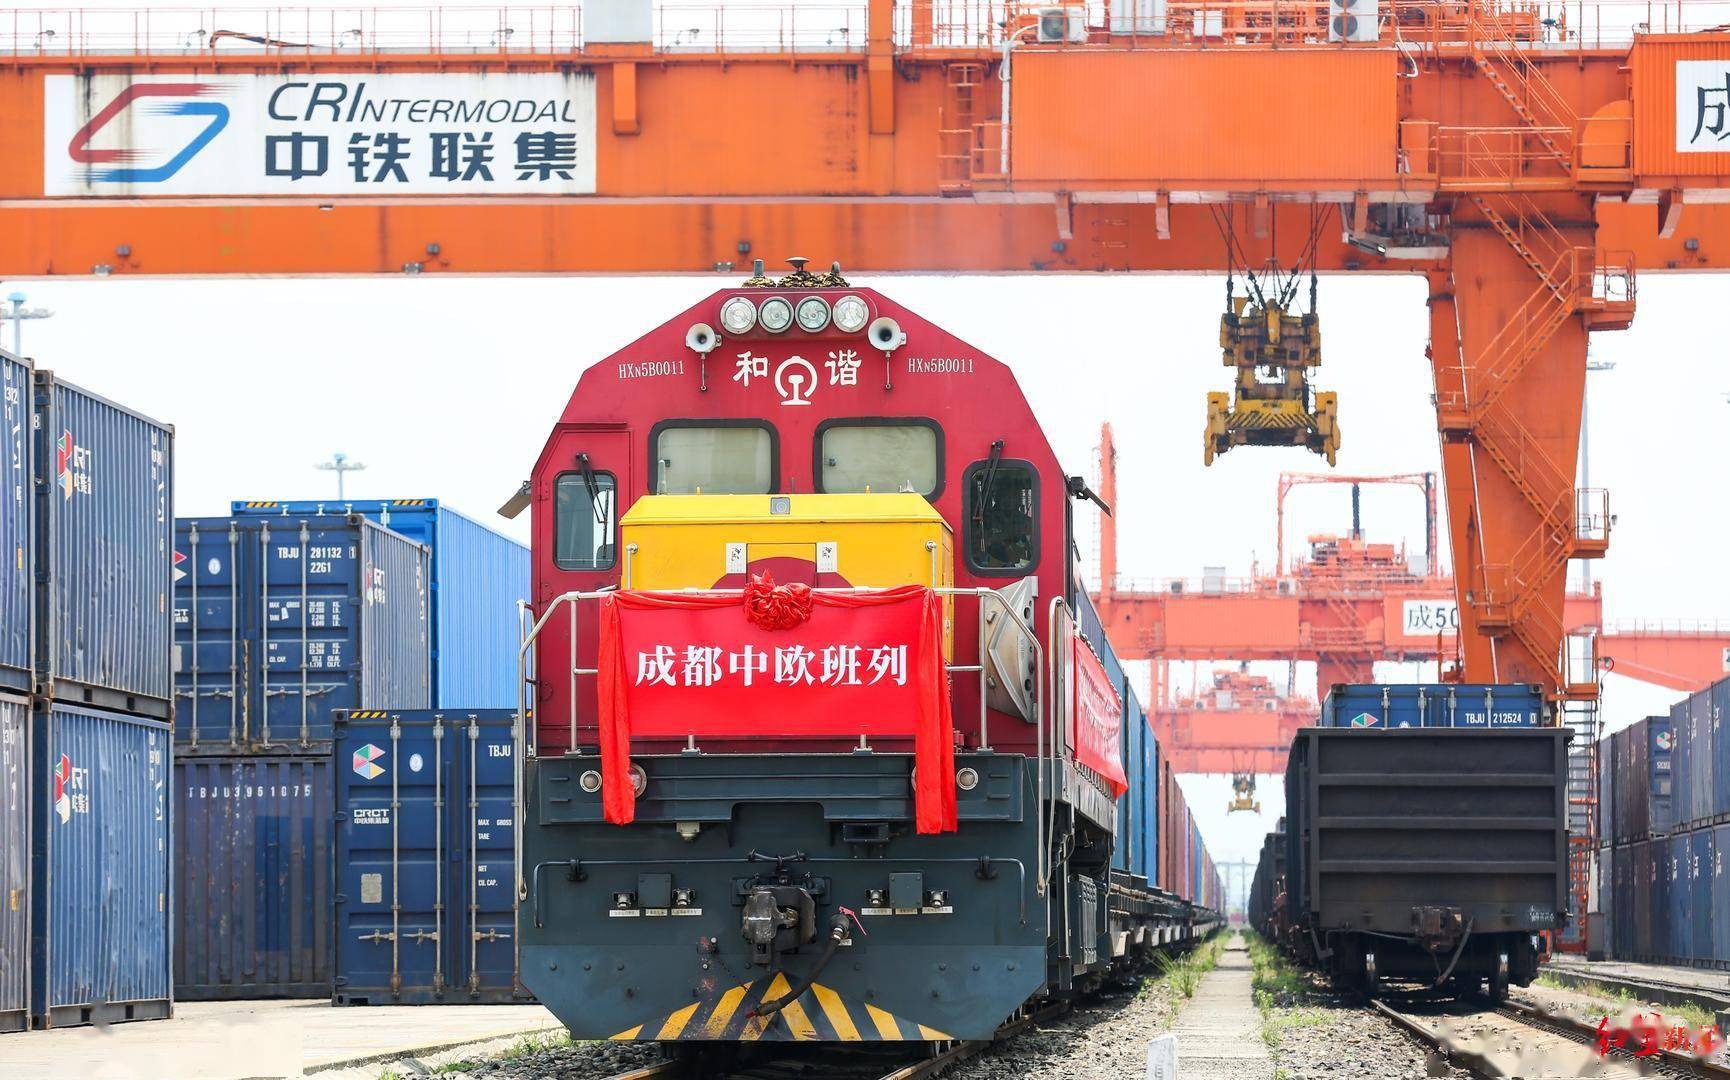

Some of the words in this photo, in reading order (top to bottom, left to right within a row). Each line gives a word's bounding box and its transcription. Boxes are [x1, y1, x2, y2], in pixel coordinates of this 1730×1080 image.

[265, 131, 578, 183] 中铁联集
[732, 351, 769, 387] 和
[824, 349, 862, 386] 谐
[277, 547, 299, 559] TBJU
[310, 547, 342, 559] 281132
[635, 644, 909, 687] 成都中欧班列
[1465, 713, 1485, 723] TBJU
[1493, 713, 1521, 723] 212524
[488, 745, 511, 757] TBJU
[189, 785, 312, 798] TBJU3961075
[354, 809, 390, 818] CRCT
